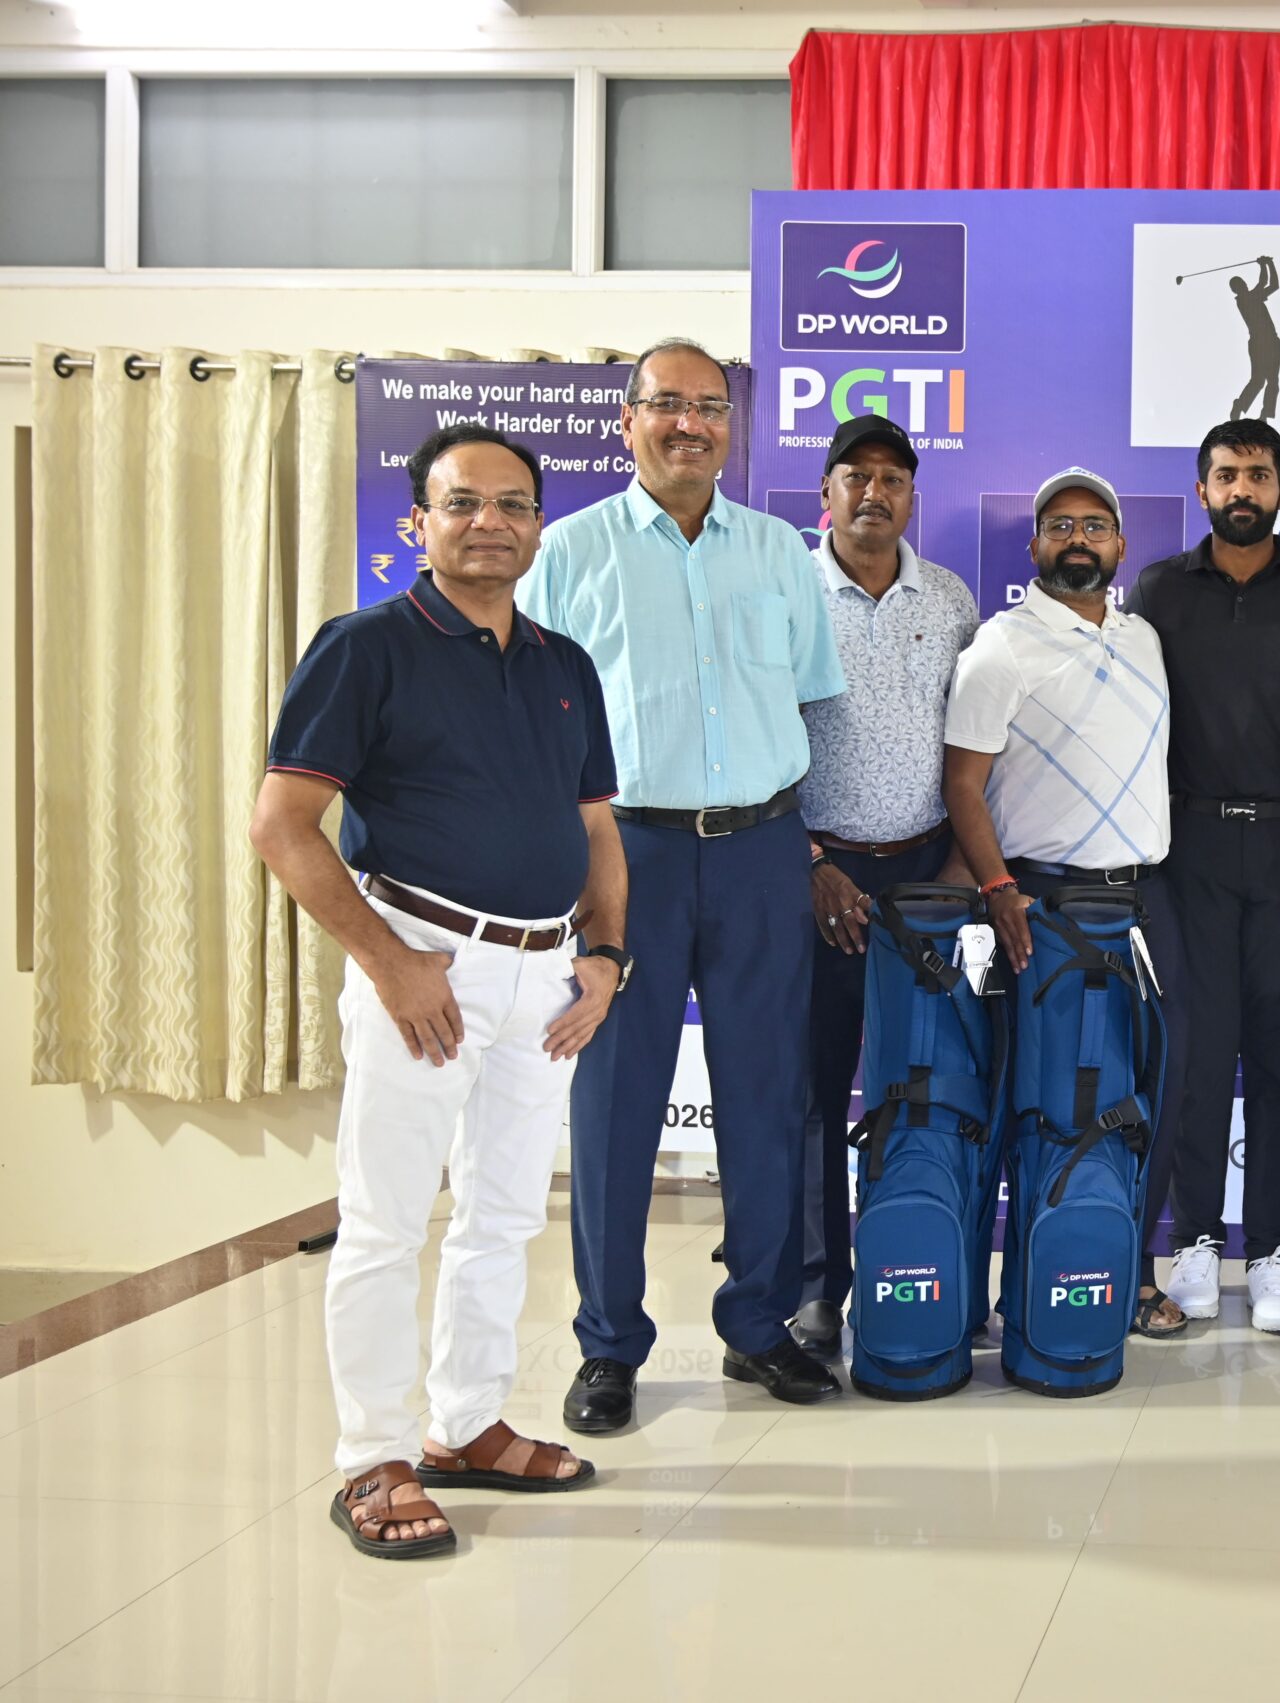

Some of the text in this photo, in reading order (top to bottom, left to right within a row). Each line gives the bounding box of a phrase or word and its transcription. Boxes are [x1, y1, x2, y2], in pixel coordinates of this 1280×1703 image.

[797, 314, 948, 336] DP WORLD
[382, 378, 625, 406] We make your hard earn
[778, 366, 966, 434] PGTI
[436, 410, 623, 439] Work Harder for yo
[779, 435, 832, 448] PROFESSIO
[917, 438, 930, 449] OF
[933, 438, 964, 450] INDIA
[540, 455, 588, 473] Power
[593, 456, 609, 472] of
[664, 1104, 713, 1128] 026
[907, 1267, 936, 1275] WORLD
[1082, 1272, 1110, 1280] WORLD
[876, 1280, 940, 1303] PGTI
[1051, 1284, 1113, 1307] PGTI
